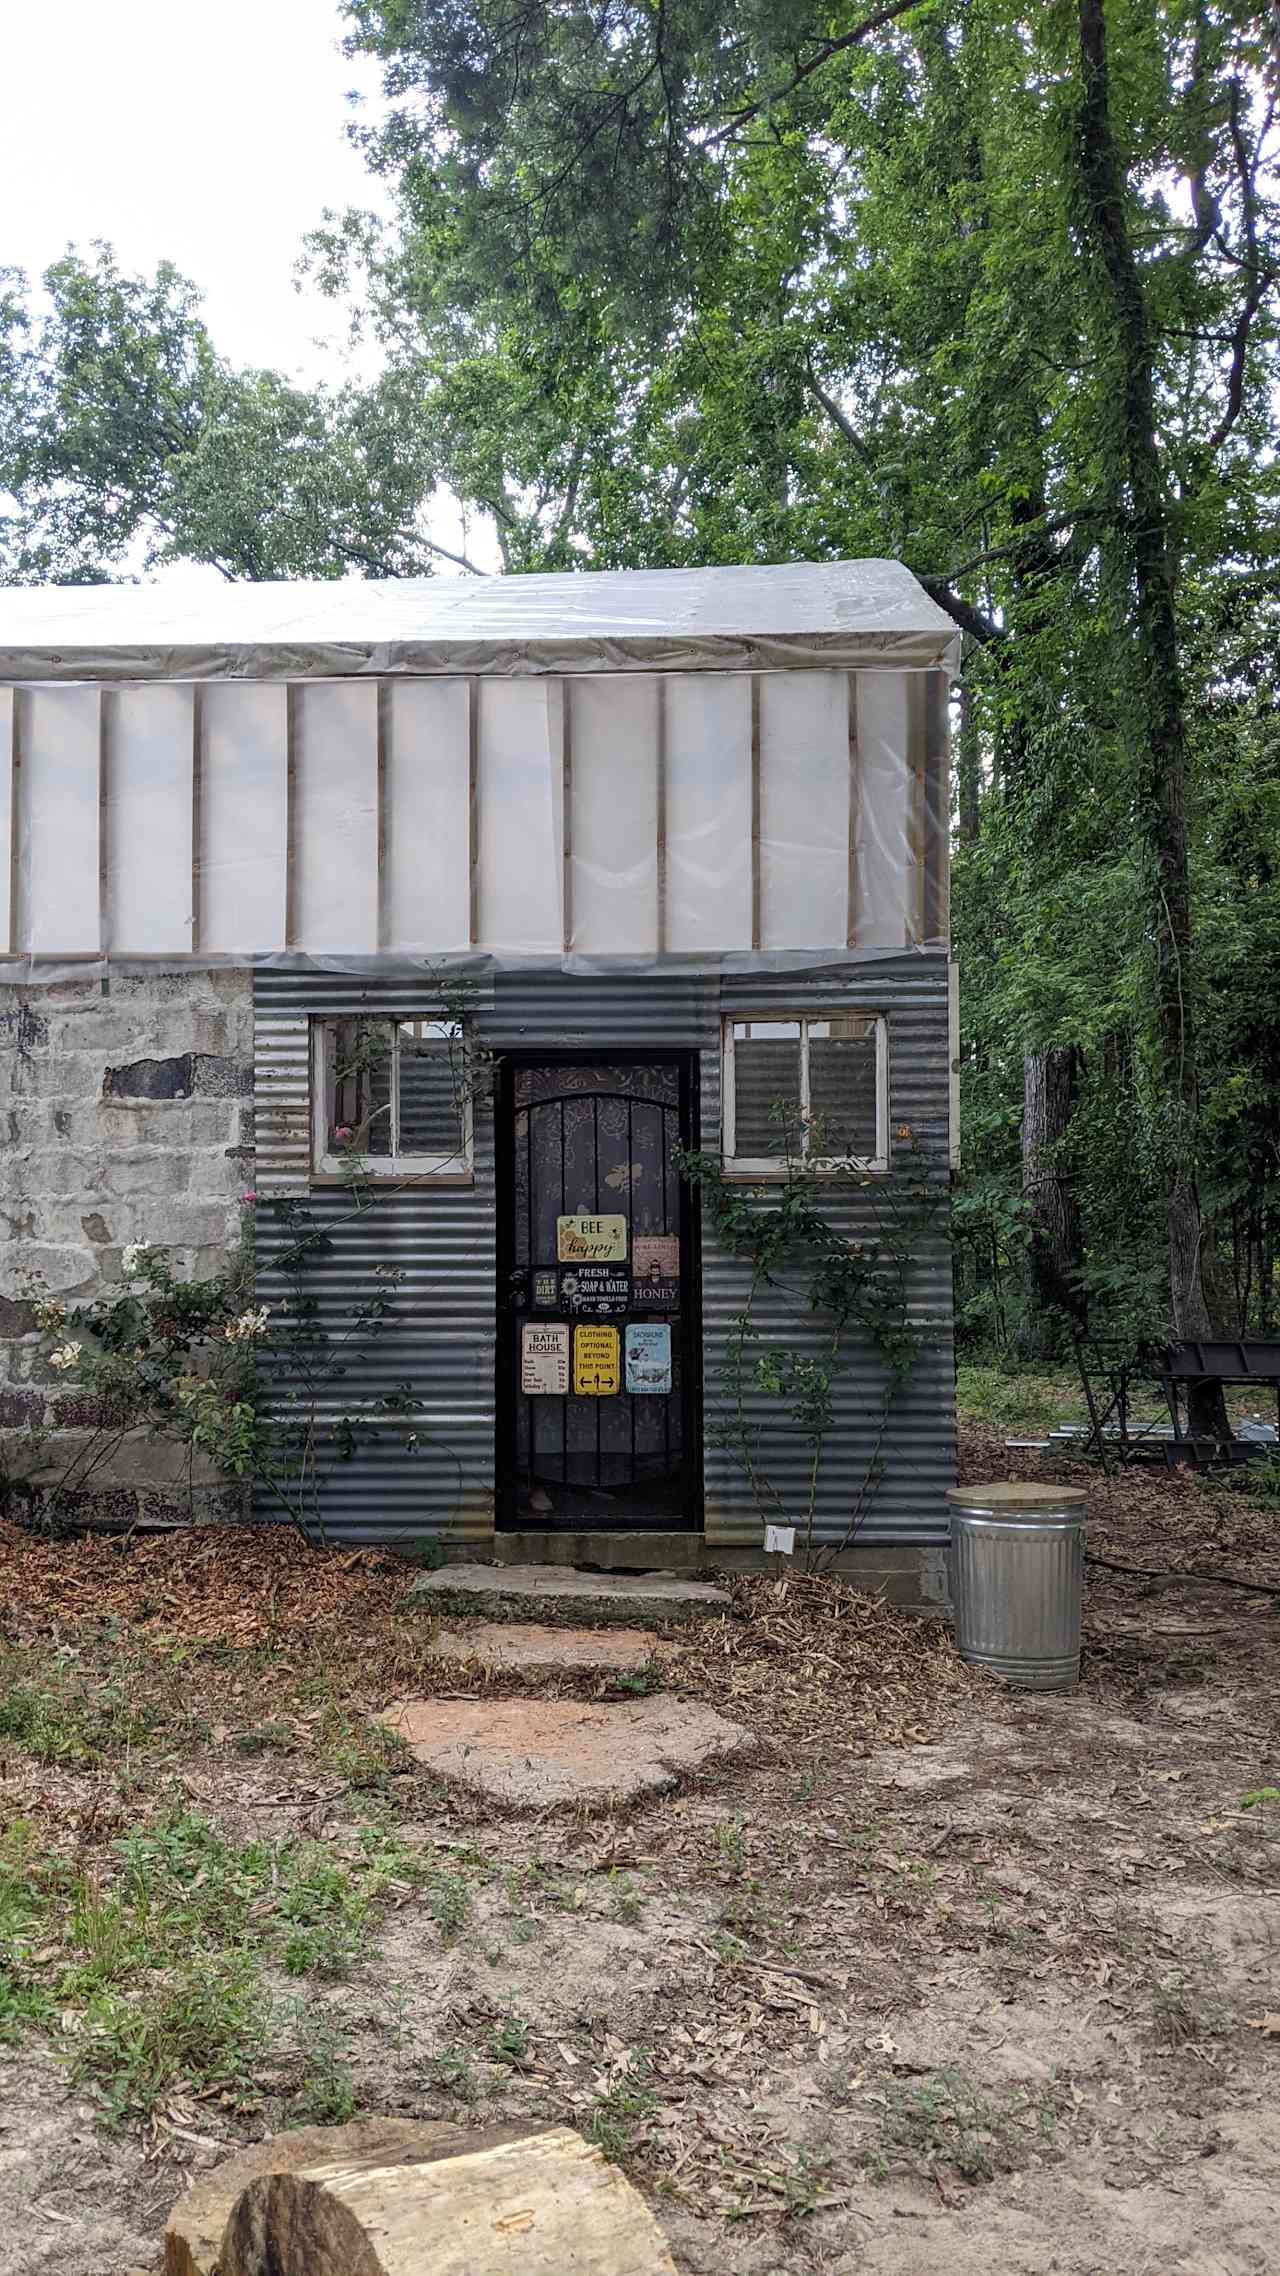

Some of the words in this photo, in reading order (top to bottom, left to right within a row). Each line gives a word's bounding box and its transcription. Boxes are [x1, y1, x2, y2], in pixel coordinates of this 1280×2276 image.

[581, 1221, 603, 1234] BEE
[568, 1239, 613, 1258] happy
[578, 1268, 609, 1277] FRESH
[581, 1281, 597, 1292] SOAP
[599, 1281, 605, 1292] &
[606, 1280, 628, 1292] WATER
[634, 1288, 676, 1299] HONEY
[529, 1343, 562, 1352] HOUSE
